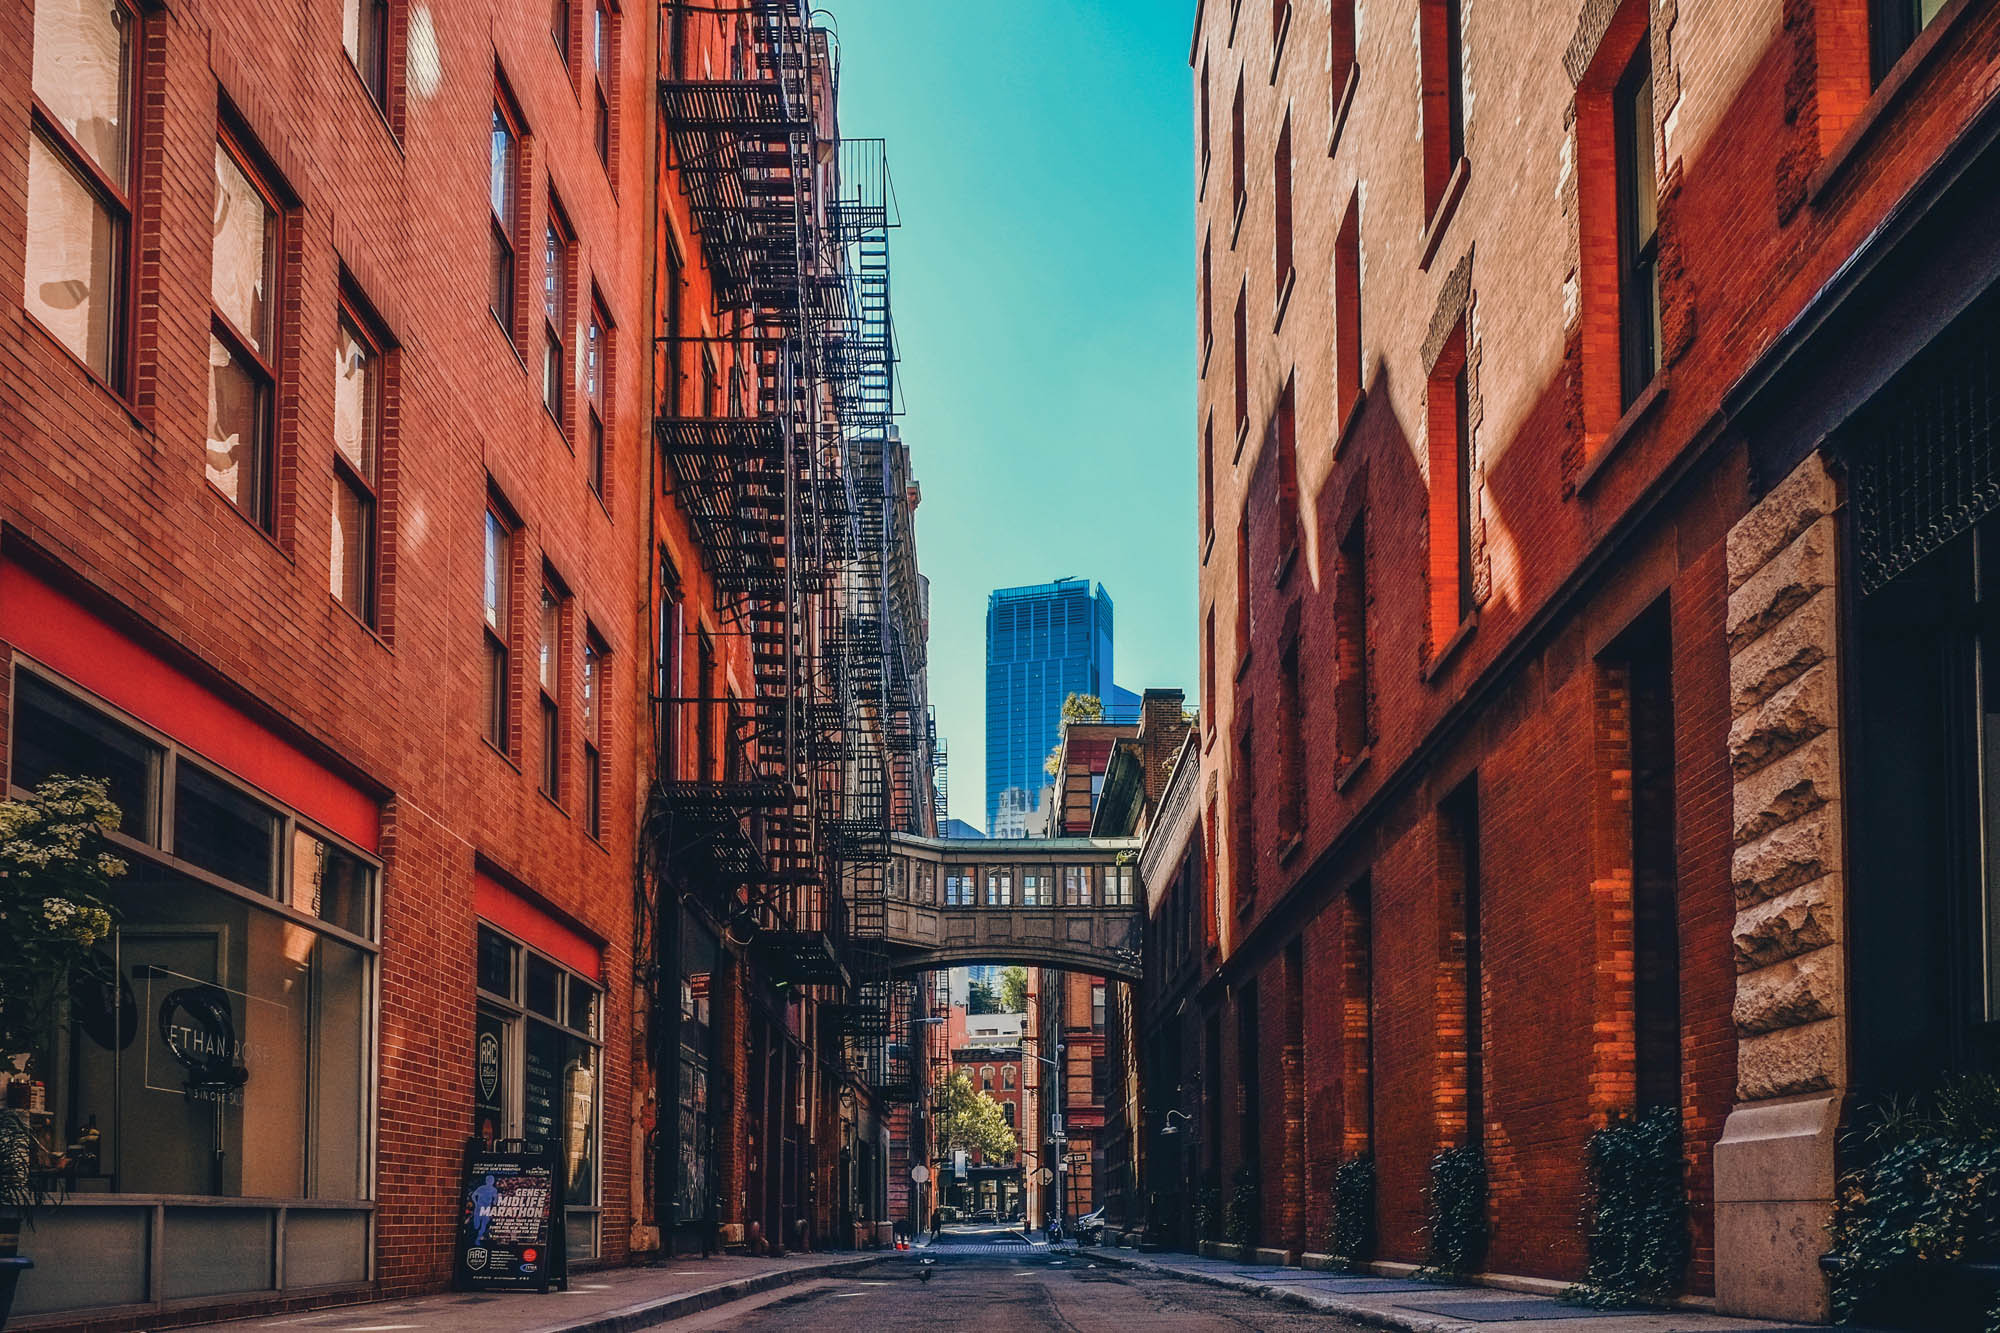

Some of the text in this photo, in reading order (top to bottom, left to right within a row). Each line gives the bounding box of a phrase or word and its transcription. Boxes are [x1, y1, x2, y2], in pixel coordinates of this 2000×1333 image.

[170, 1025, 226, 1057] ETHAN
[482, 1040, 497, 1064] ARC
[515, 1188, 547, 1197] GENE'S
[497, 1196, 545, 1207] MIDLIFE
[479, 1206, 543, 1217] MARATHON
[470, 1250, 485, 1258] ARC
